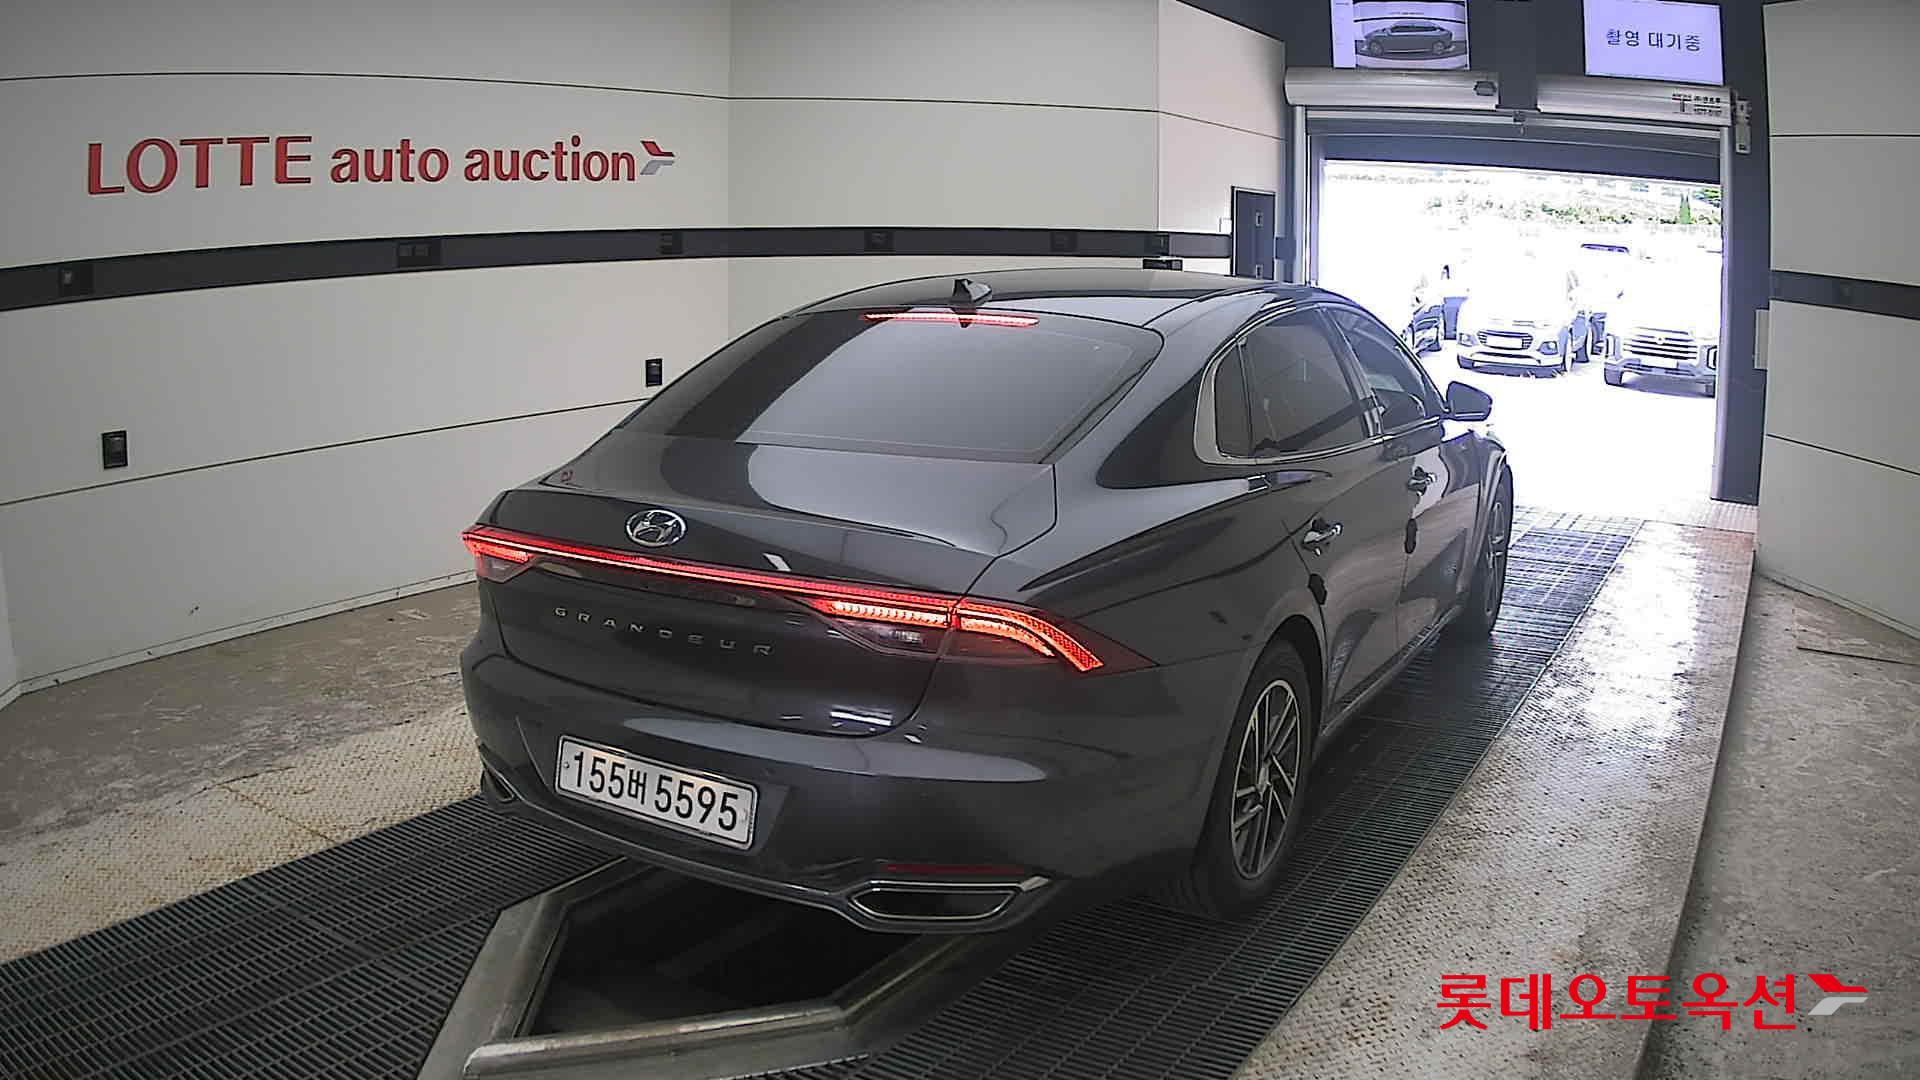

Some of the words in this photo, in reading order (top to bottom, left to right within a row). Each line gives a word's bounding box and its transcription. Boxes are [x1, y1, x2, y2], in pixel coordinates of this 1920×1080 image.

[1606, 28, 1640, 47] 촬영
[1648, 32, 1701, 52] 대기중
[87, 136, 312, 195] LOTTE
[330, 138, 449, 183] auto
[463, 135, 635, 182] auction
[554, 606, 772, 657] GRANDEUR
[654, 774, 739, 832] 5595
